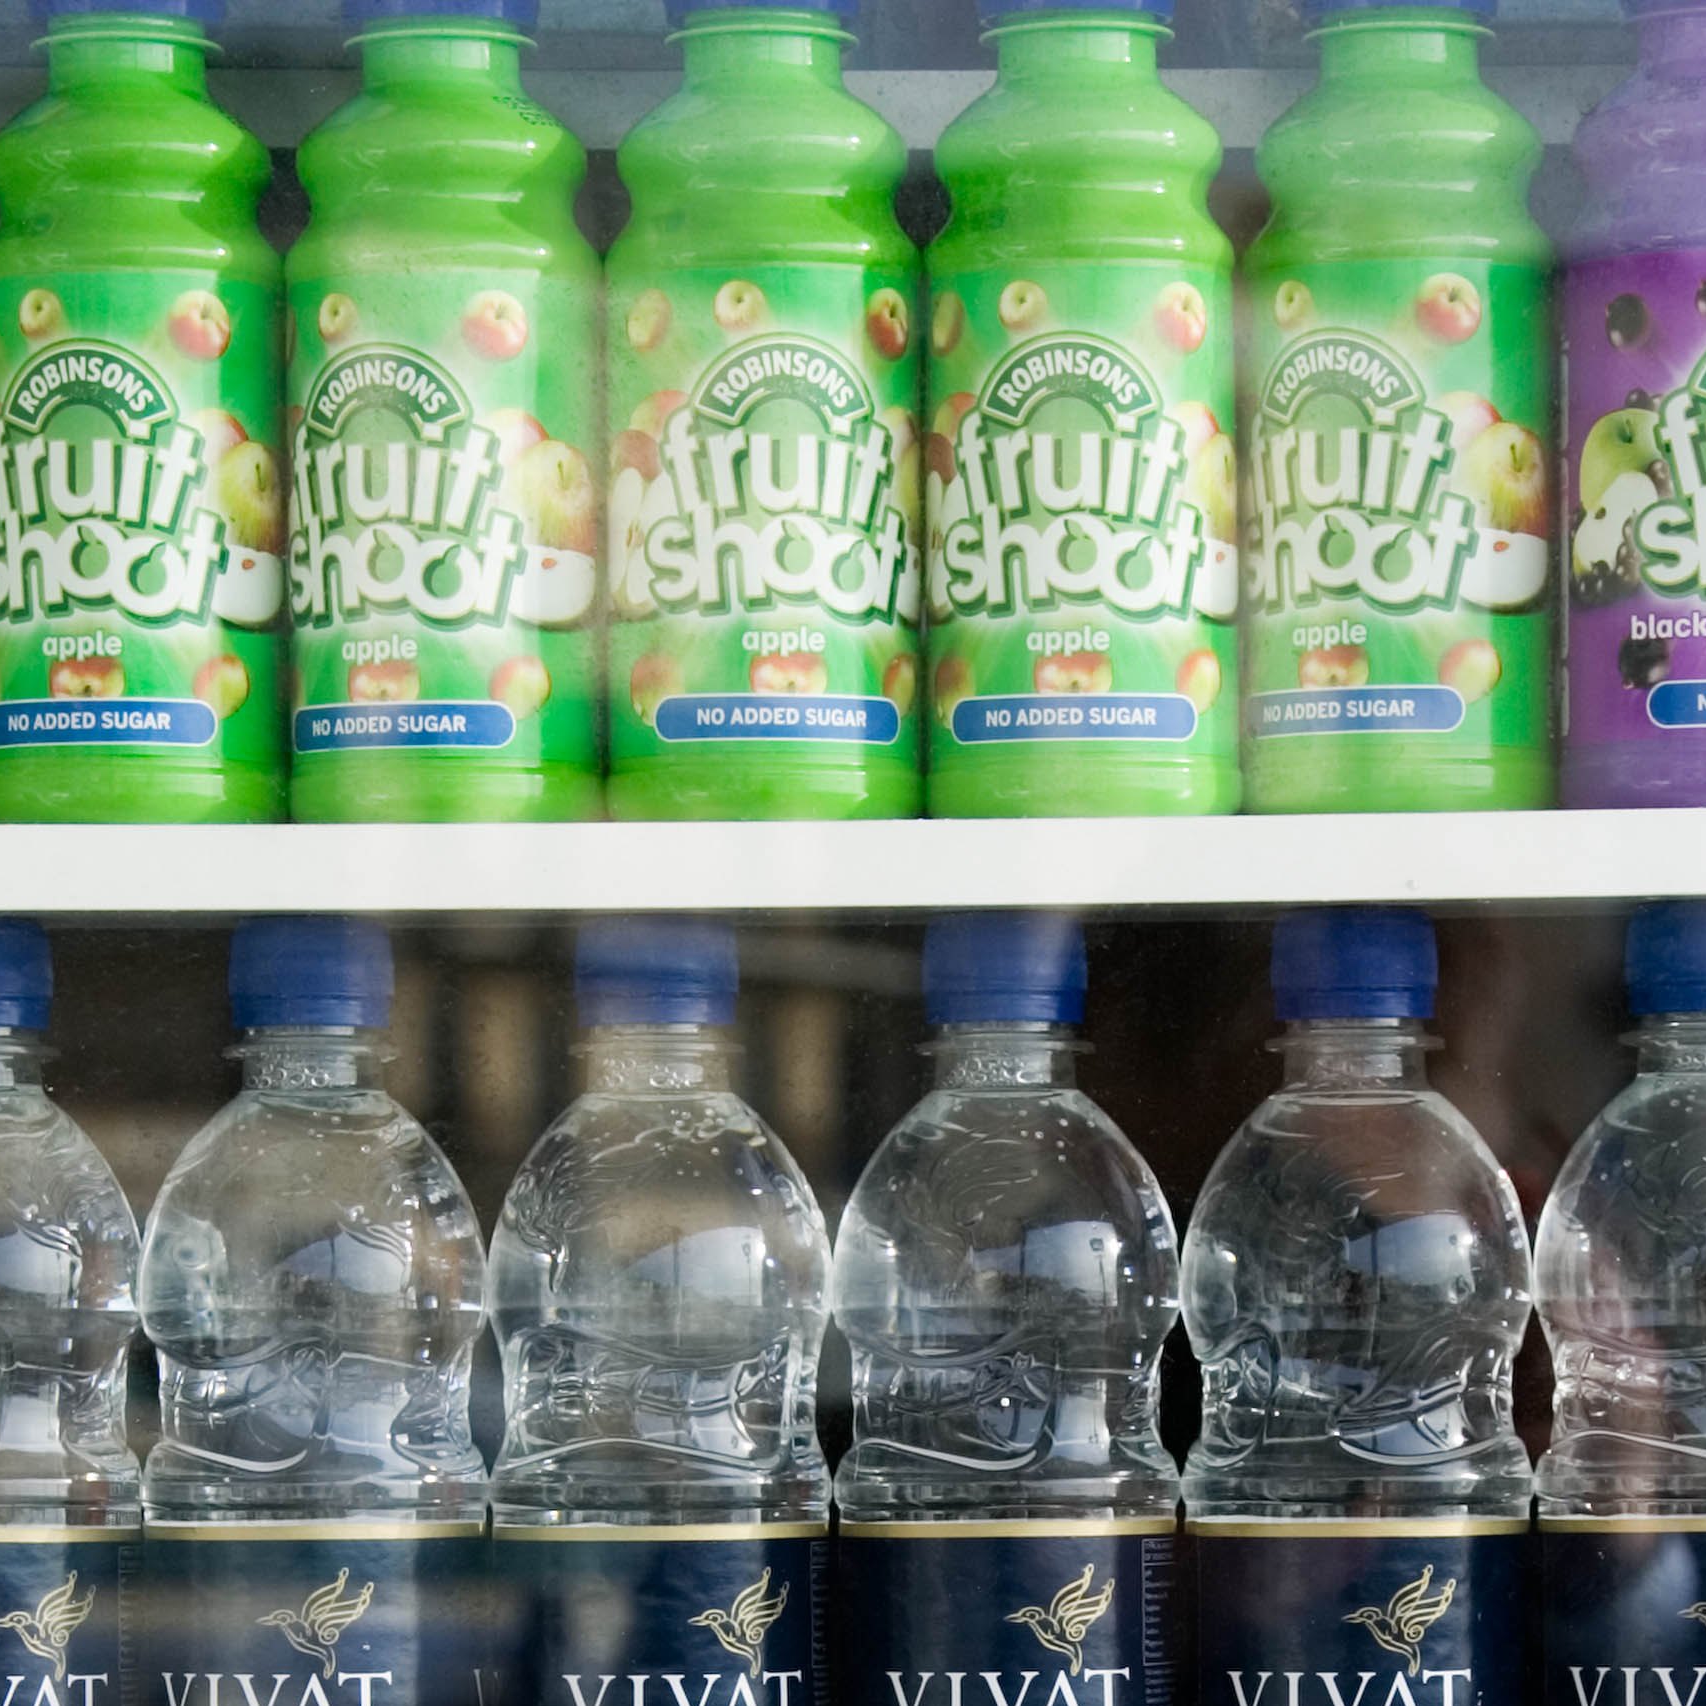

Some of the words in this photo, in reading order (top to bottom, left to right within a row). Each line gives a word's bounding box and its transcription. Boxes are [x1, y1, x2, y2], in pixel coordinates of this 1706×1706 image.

[714, 349, 854, 408] ROBINSONS
[998, 348, 1140, 406] ROBINSONS
[664, 410, 887, 520] fruit
[959, 411, 1178, 519] fruit
[650, 502, 902, 613] shoot
[946, 498, 1198, 610] shoot
[743, 626, 826, 657] apple
[1027, 625, 1111, 656] apple
[697, 708, 725, 725] NO
[730, 707, 801, 726] ADDED
[805, 707, 866, 728] SUGAR
[986, 710, 1011, 727] NO
[1017, 707, 1084, 725] ADDED
[1089, 707, 1156, 725] SUGAR
